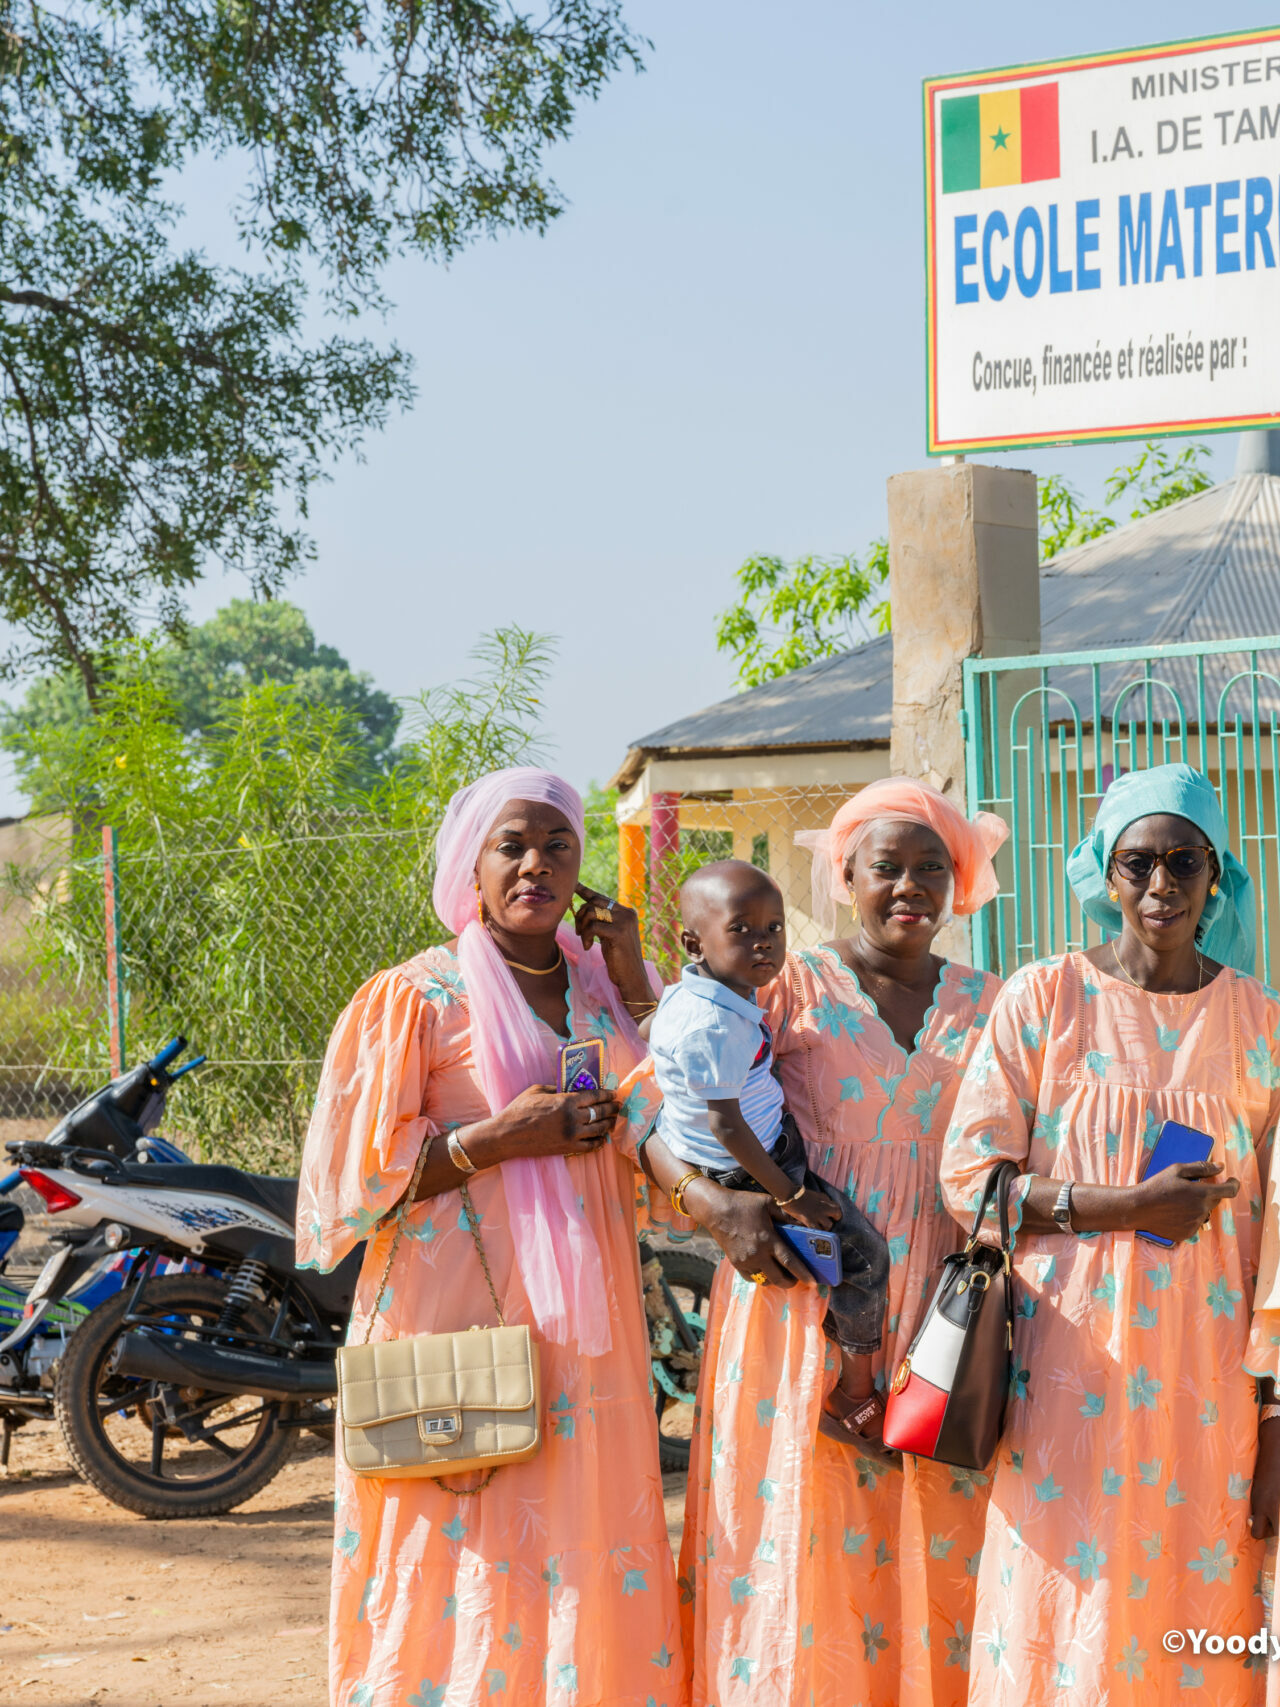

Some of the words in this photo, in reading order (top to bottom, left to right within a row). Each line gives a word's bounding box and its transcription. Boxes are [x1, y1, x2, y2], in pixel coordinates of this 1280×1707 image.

[1091, 125, 1143, 163] I.A.
[1157, 115, 1201, 155] DE
[954, 198, 1101, 305] ECOLE
[971, 349, 1037, 396] Concue,
[1042, 338, 1112, 386] financée
[1117, 346, 1133, 379] et
[1139, 330, 1205, 378] réalisée
[1210, 337, 1238, 382] par
